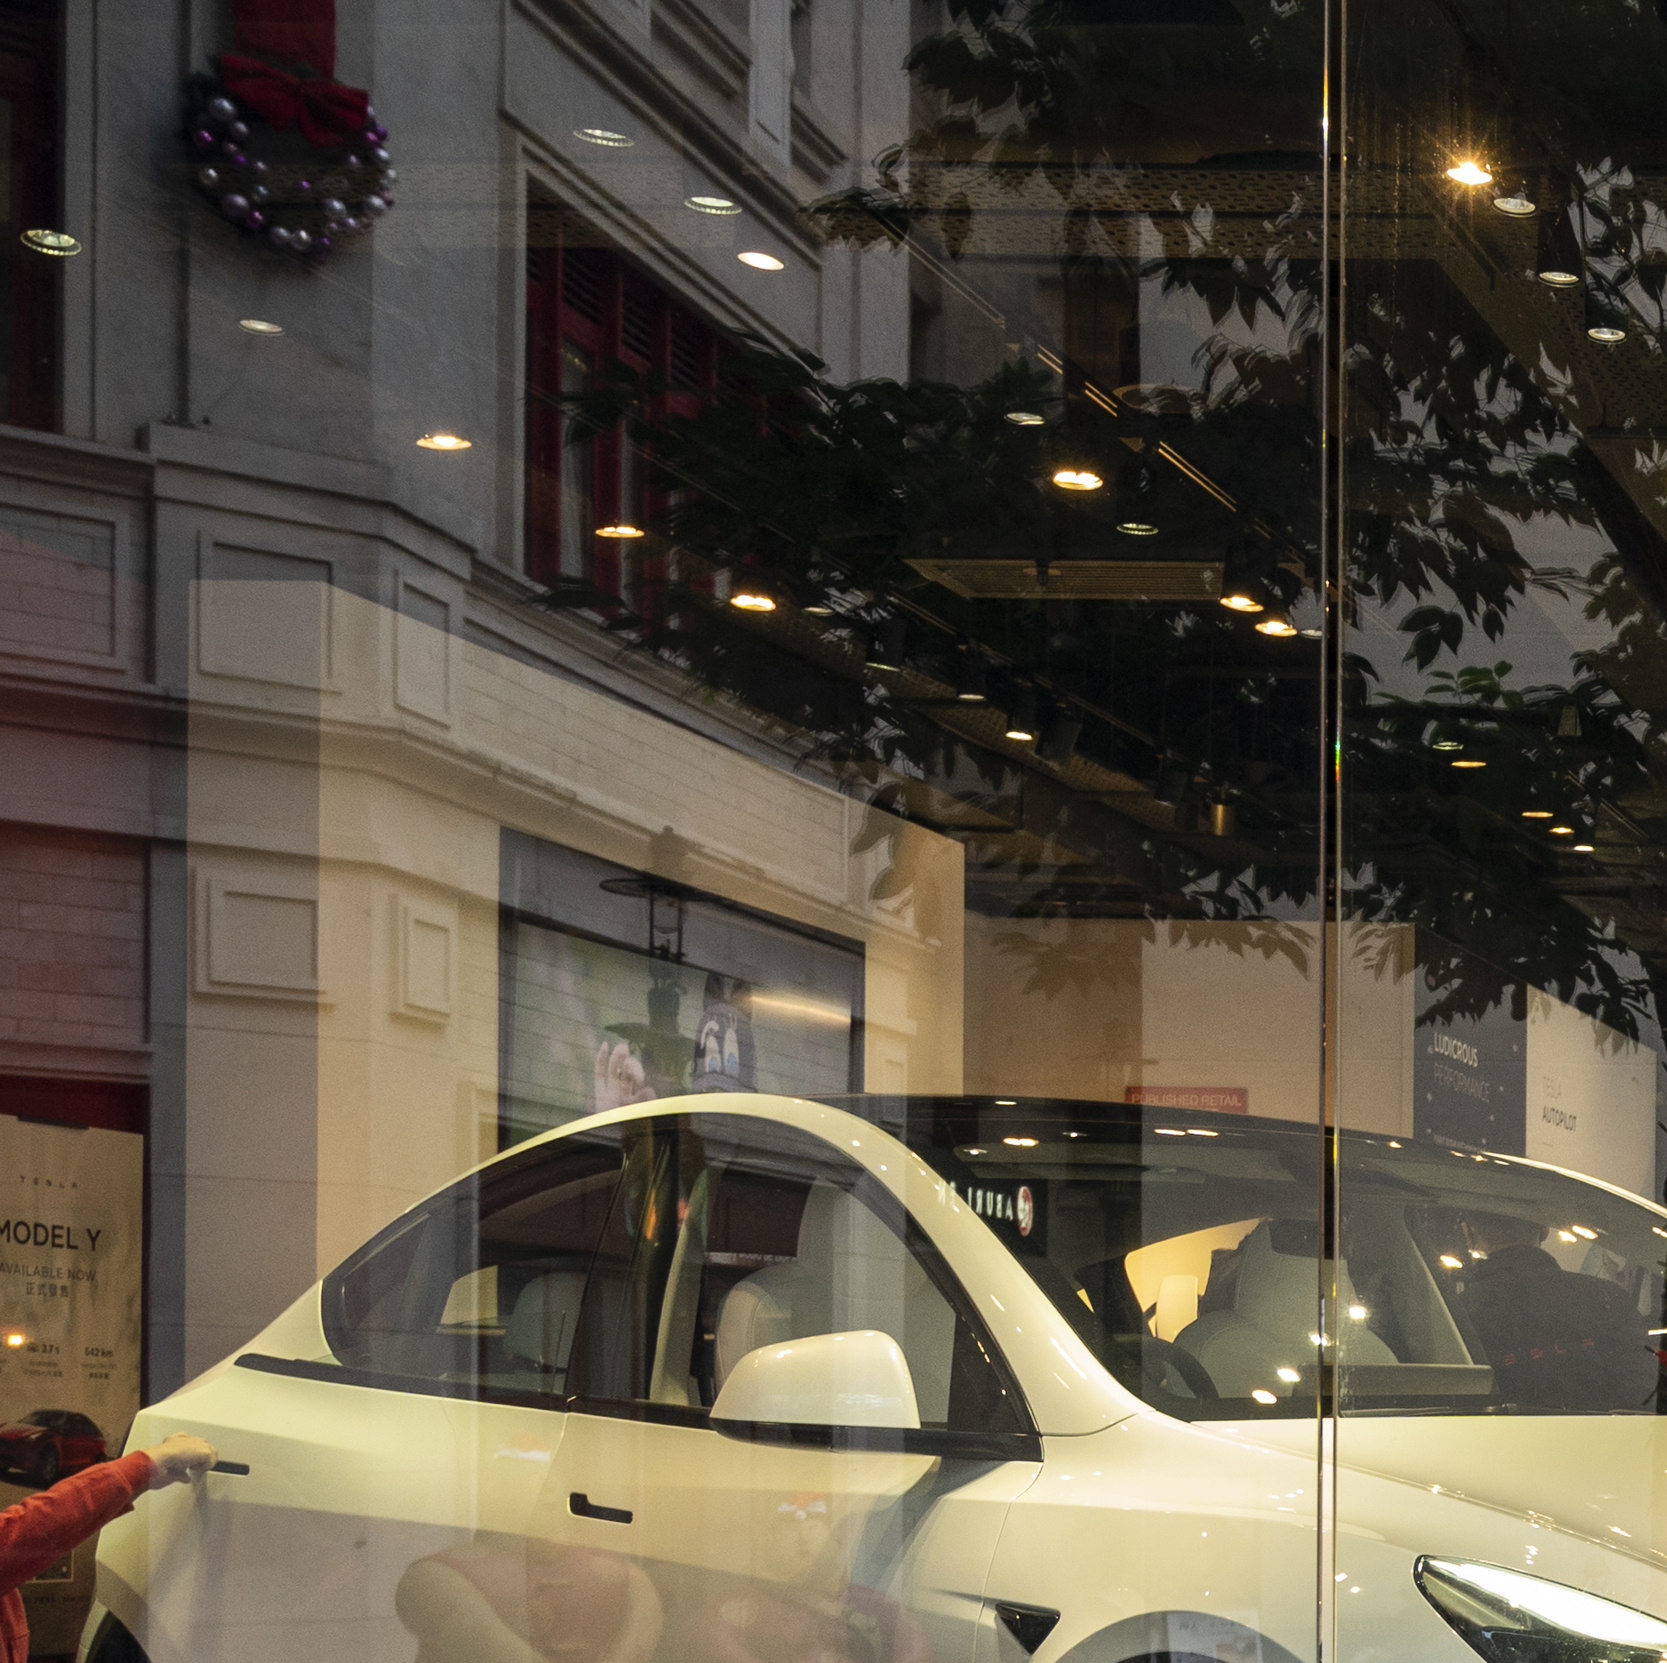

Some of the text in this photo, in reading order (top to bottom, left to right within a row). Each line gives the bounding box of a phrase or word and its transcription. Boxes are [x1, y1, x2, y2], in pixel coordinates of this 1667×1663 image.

[1434, 1031, 1478, 1068] LUDICROUS
[1542, 1105, 1577, 1131] AUTOPILOT
[86, 1228, 102, 1252] Y
[1503, 1337, 1597, 1367] ESLA
